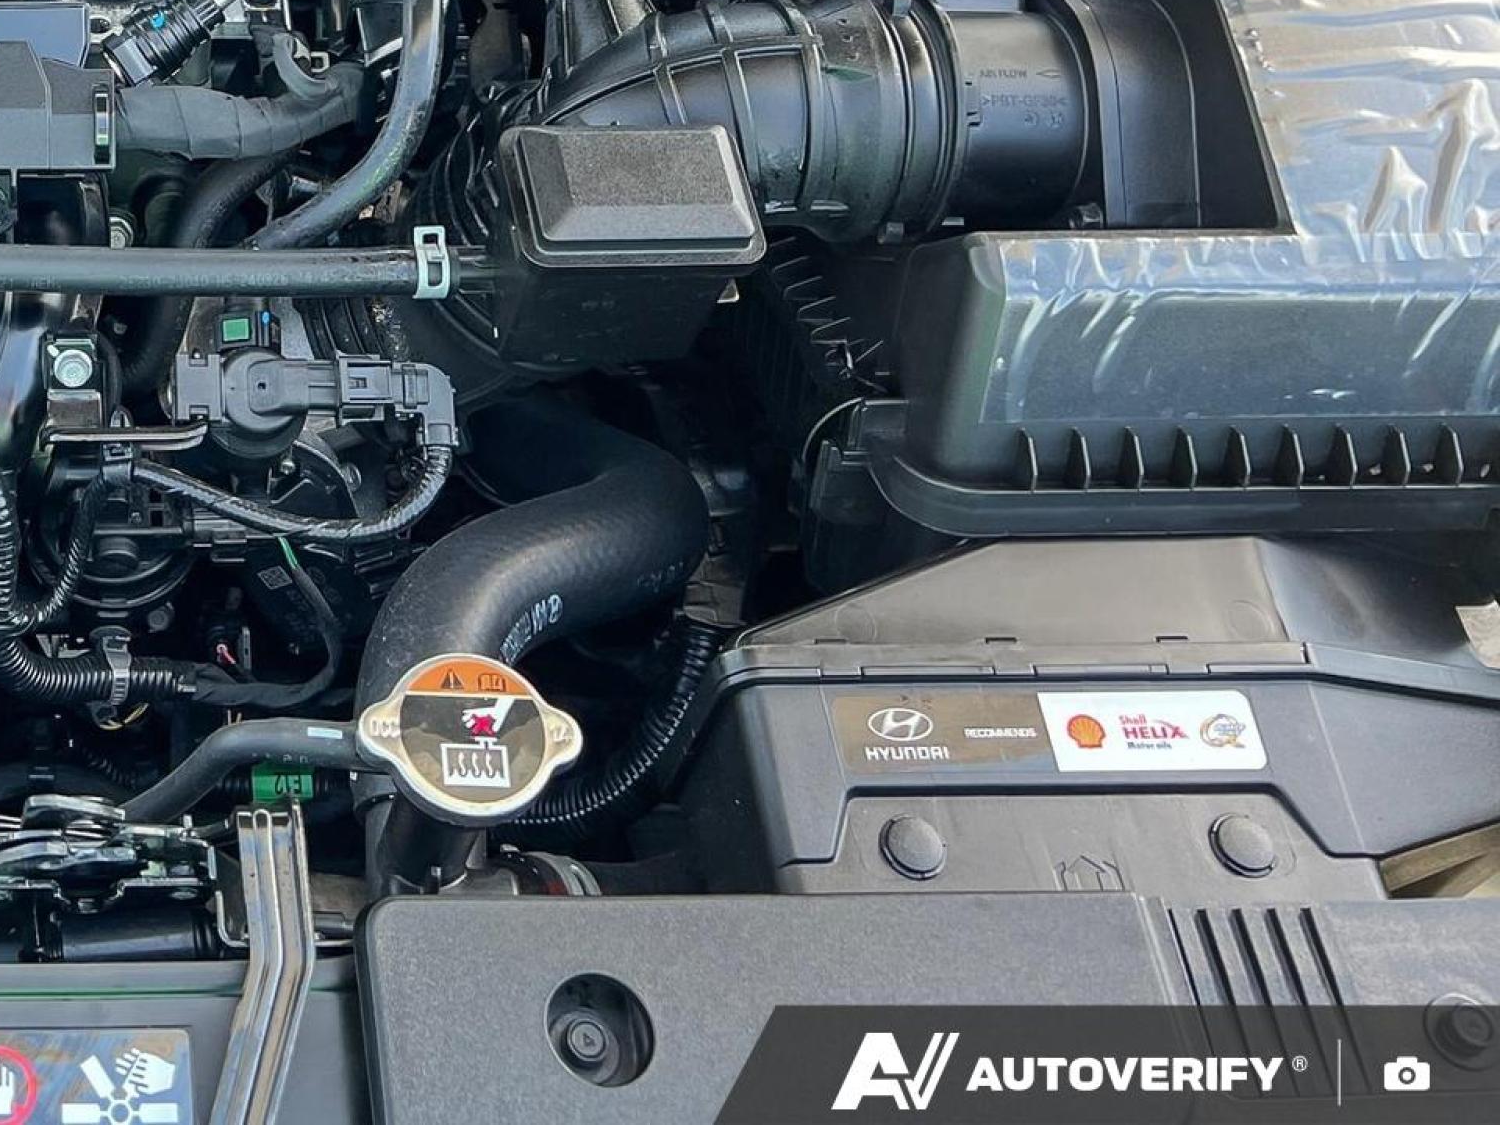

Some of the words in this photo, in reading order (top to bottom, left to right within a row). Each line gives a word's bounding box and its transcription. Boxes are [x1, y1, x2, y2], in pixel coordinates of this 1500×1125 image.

[1118, 713, 1146, 725] Shell
[1122, 726, 1188, 740] HELIX
[864, 746, 950, 761] HYUNDAI
